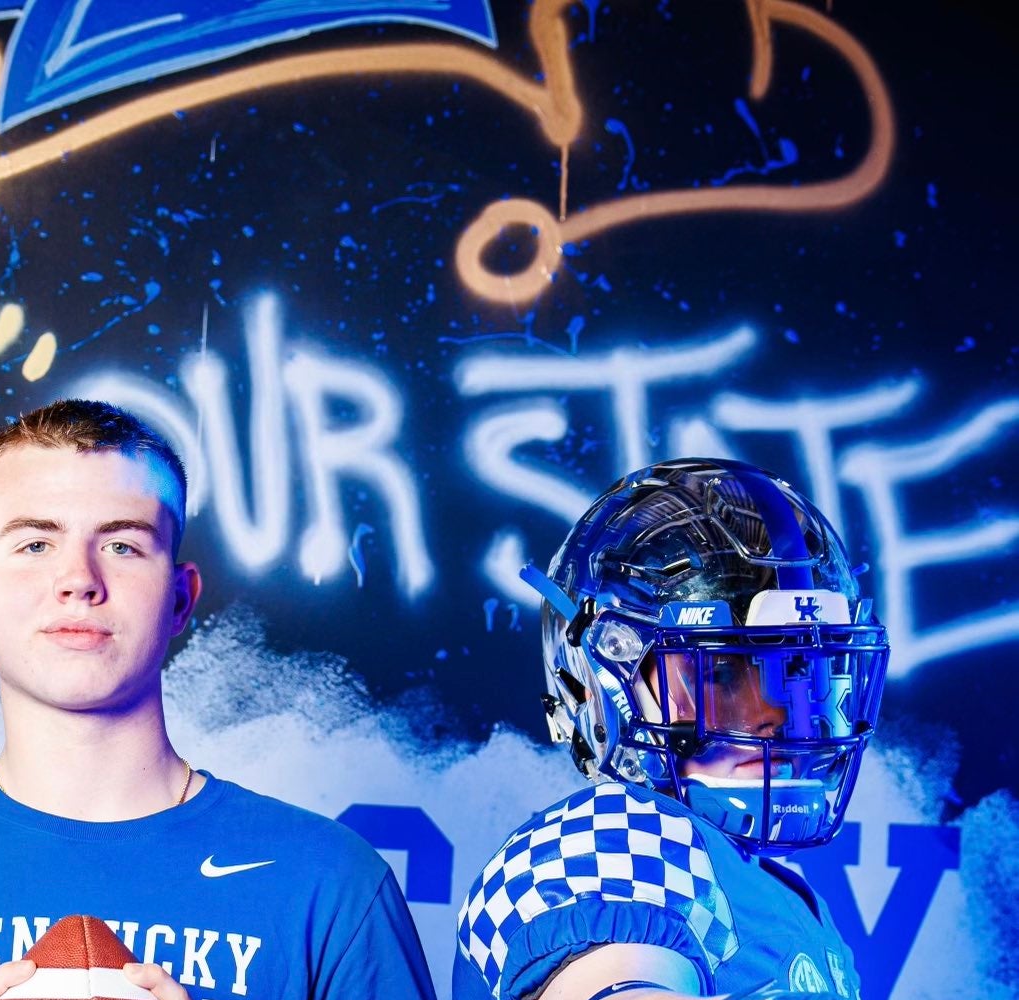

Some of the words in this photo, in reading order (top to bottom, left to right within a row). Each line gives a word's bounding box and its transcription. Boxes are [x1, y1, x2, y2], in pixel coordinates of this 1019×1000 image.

[456, 322, 1019, 680] STTE
[676, 606, 716, 625] NIKE
[772, 804, 809, 814] Riddell
